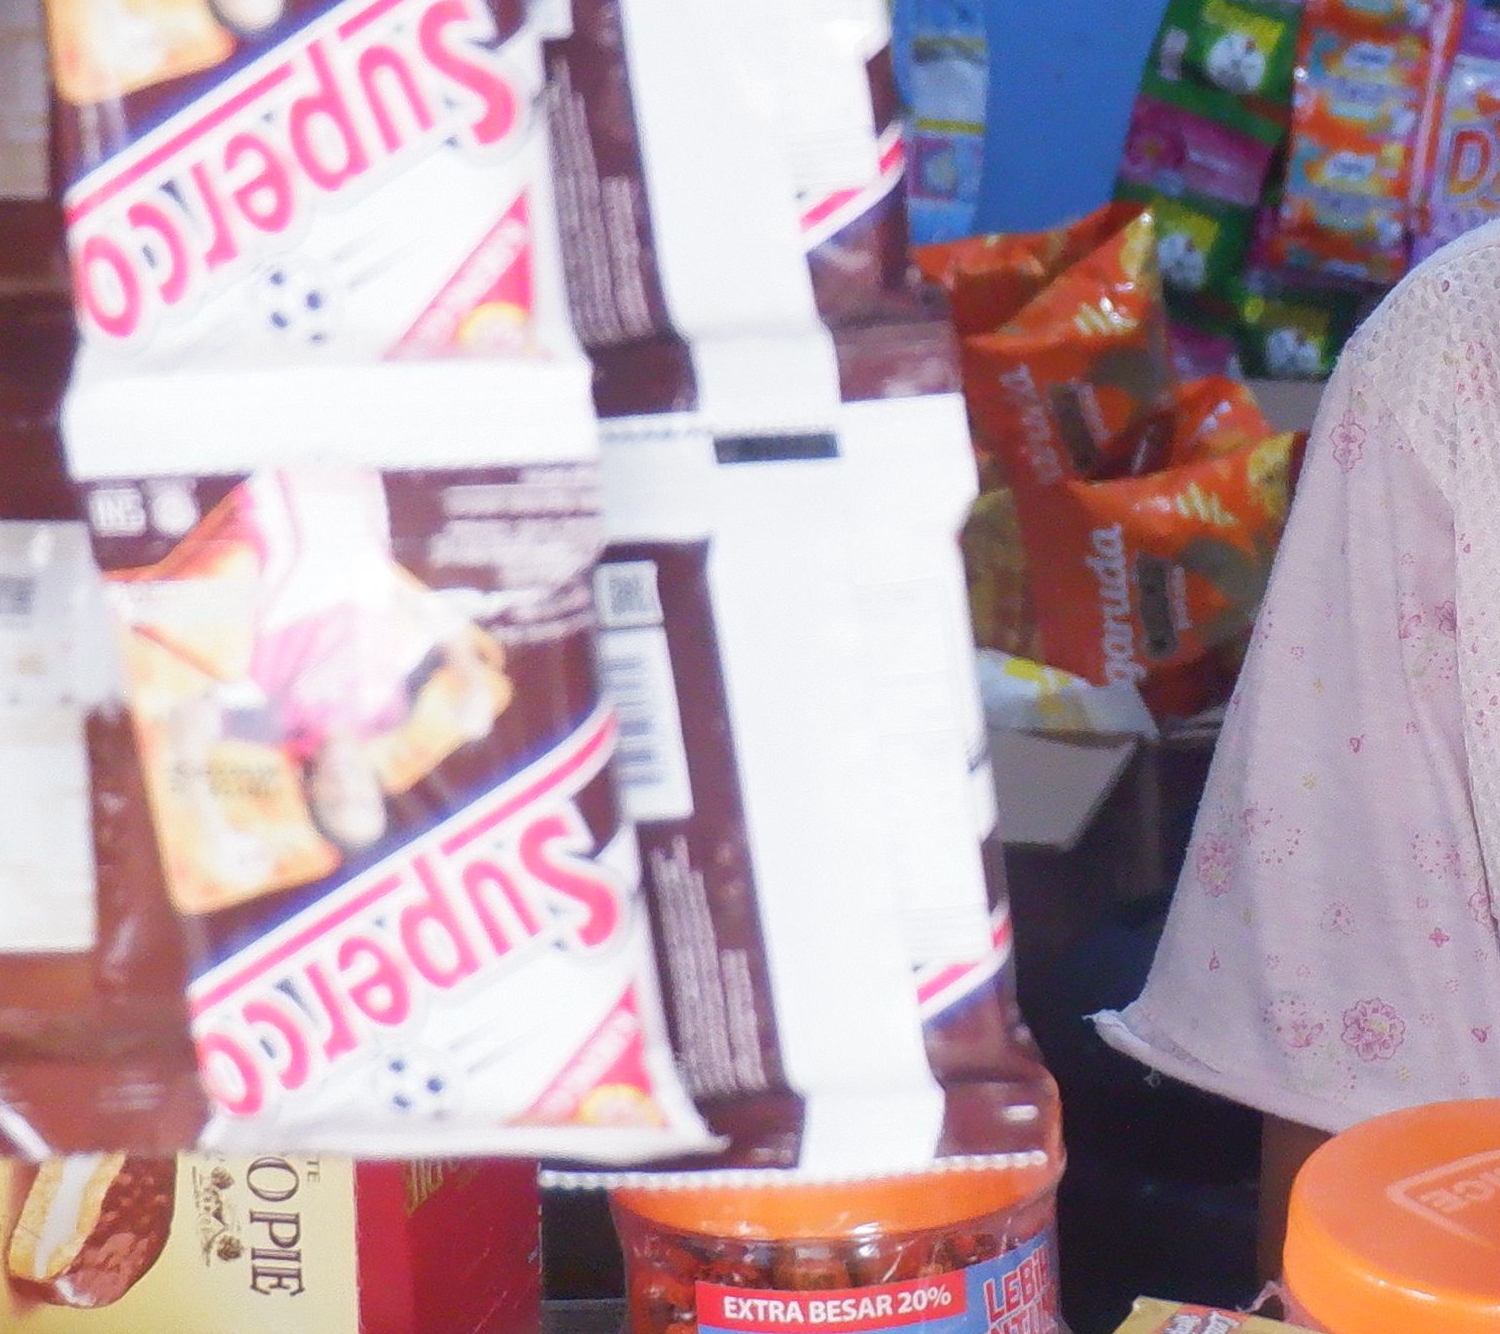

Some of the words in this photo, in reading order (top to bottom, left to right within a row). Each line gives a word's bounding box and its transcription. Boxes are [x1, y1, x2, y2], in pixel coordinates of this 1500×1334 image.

[248, 1208, 306, 1298] PIE
[721, 1293, 805, 1325] EXTRA
[808, 1292, 895, 1327] BESAR
[897, 1281, 955, 1316] 20%
